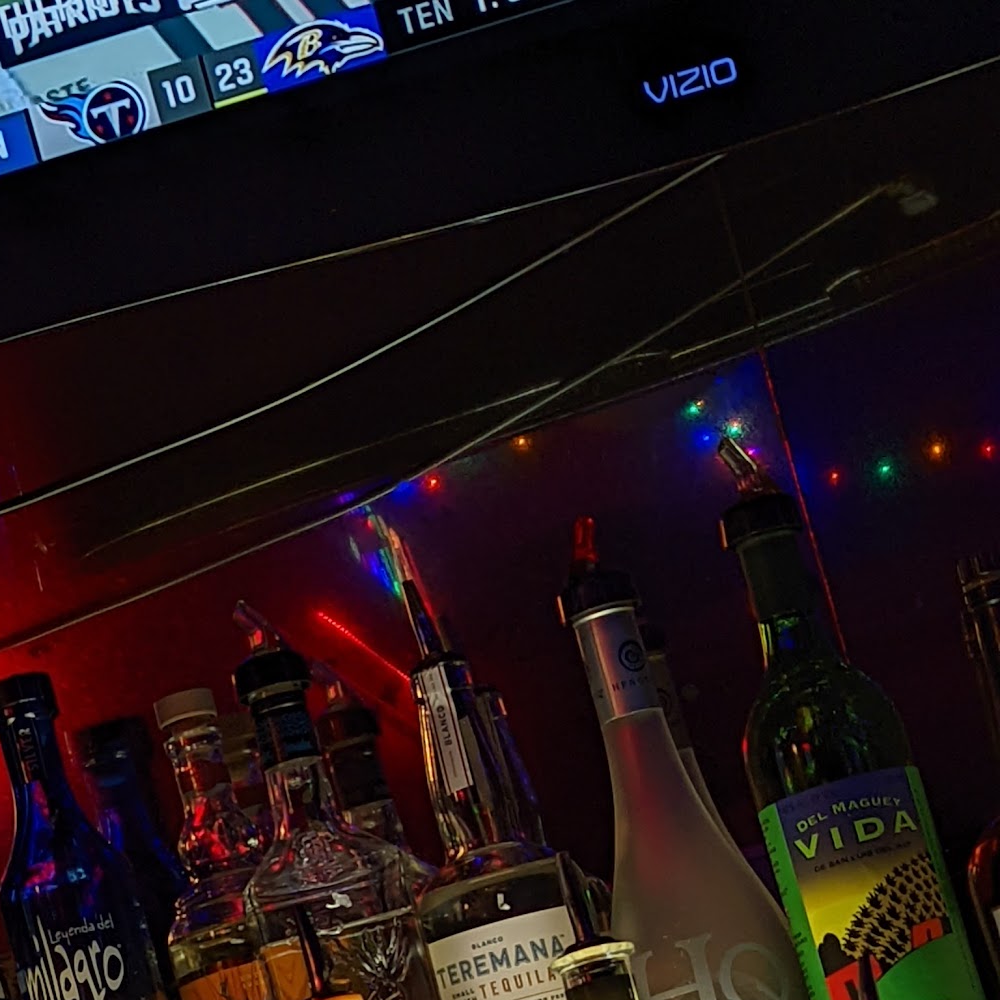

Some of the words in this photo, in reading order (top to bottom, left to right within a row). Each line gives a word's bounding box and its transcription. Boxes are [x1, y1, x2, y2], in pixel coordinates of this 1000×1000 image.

[161, 75, 196, 109] 10
[214, 60, 255, 92] 23
[397, 2, 454, 35] TEN
[643, 56, 738, 104] VIZIO
[794, 809, 918, 861] VIDA
[795, 811, 828, 834] DEL
[831, 795, 902, 816] MAGUEY
[47, 915, 96, 947] Leyenda
[96, 912, 115, 932] del
[471, 935, 504, 951] BLANCO
[436, 934, 566, 990] TEREMANA
[479, 966, 558, 1000] TEQUILA
